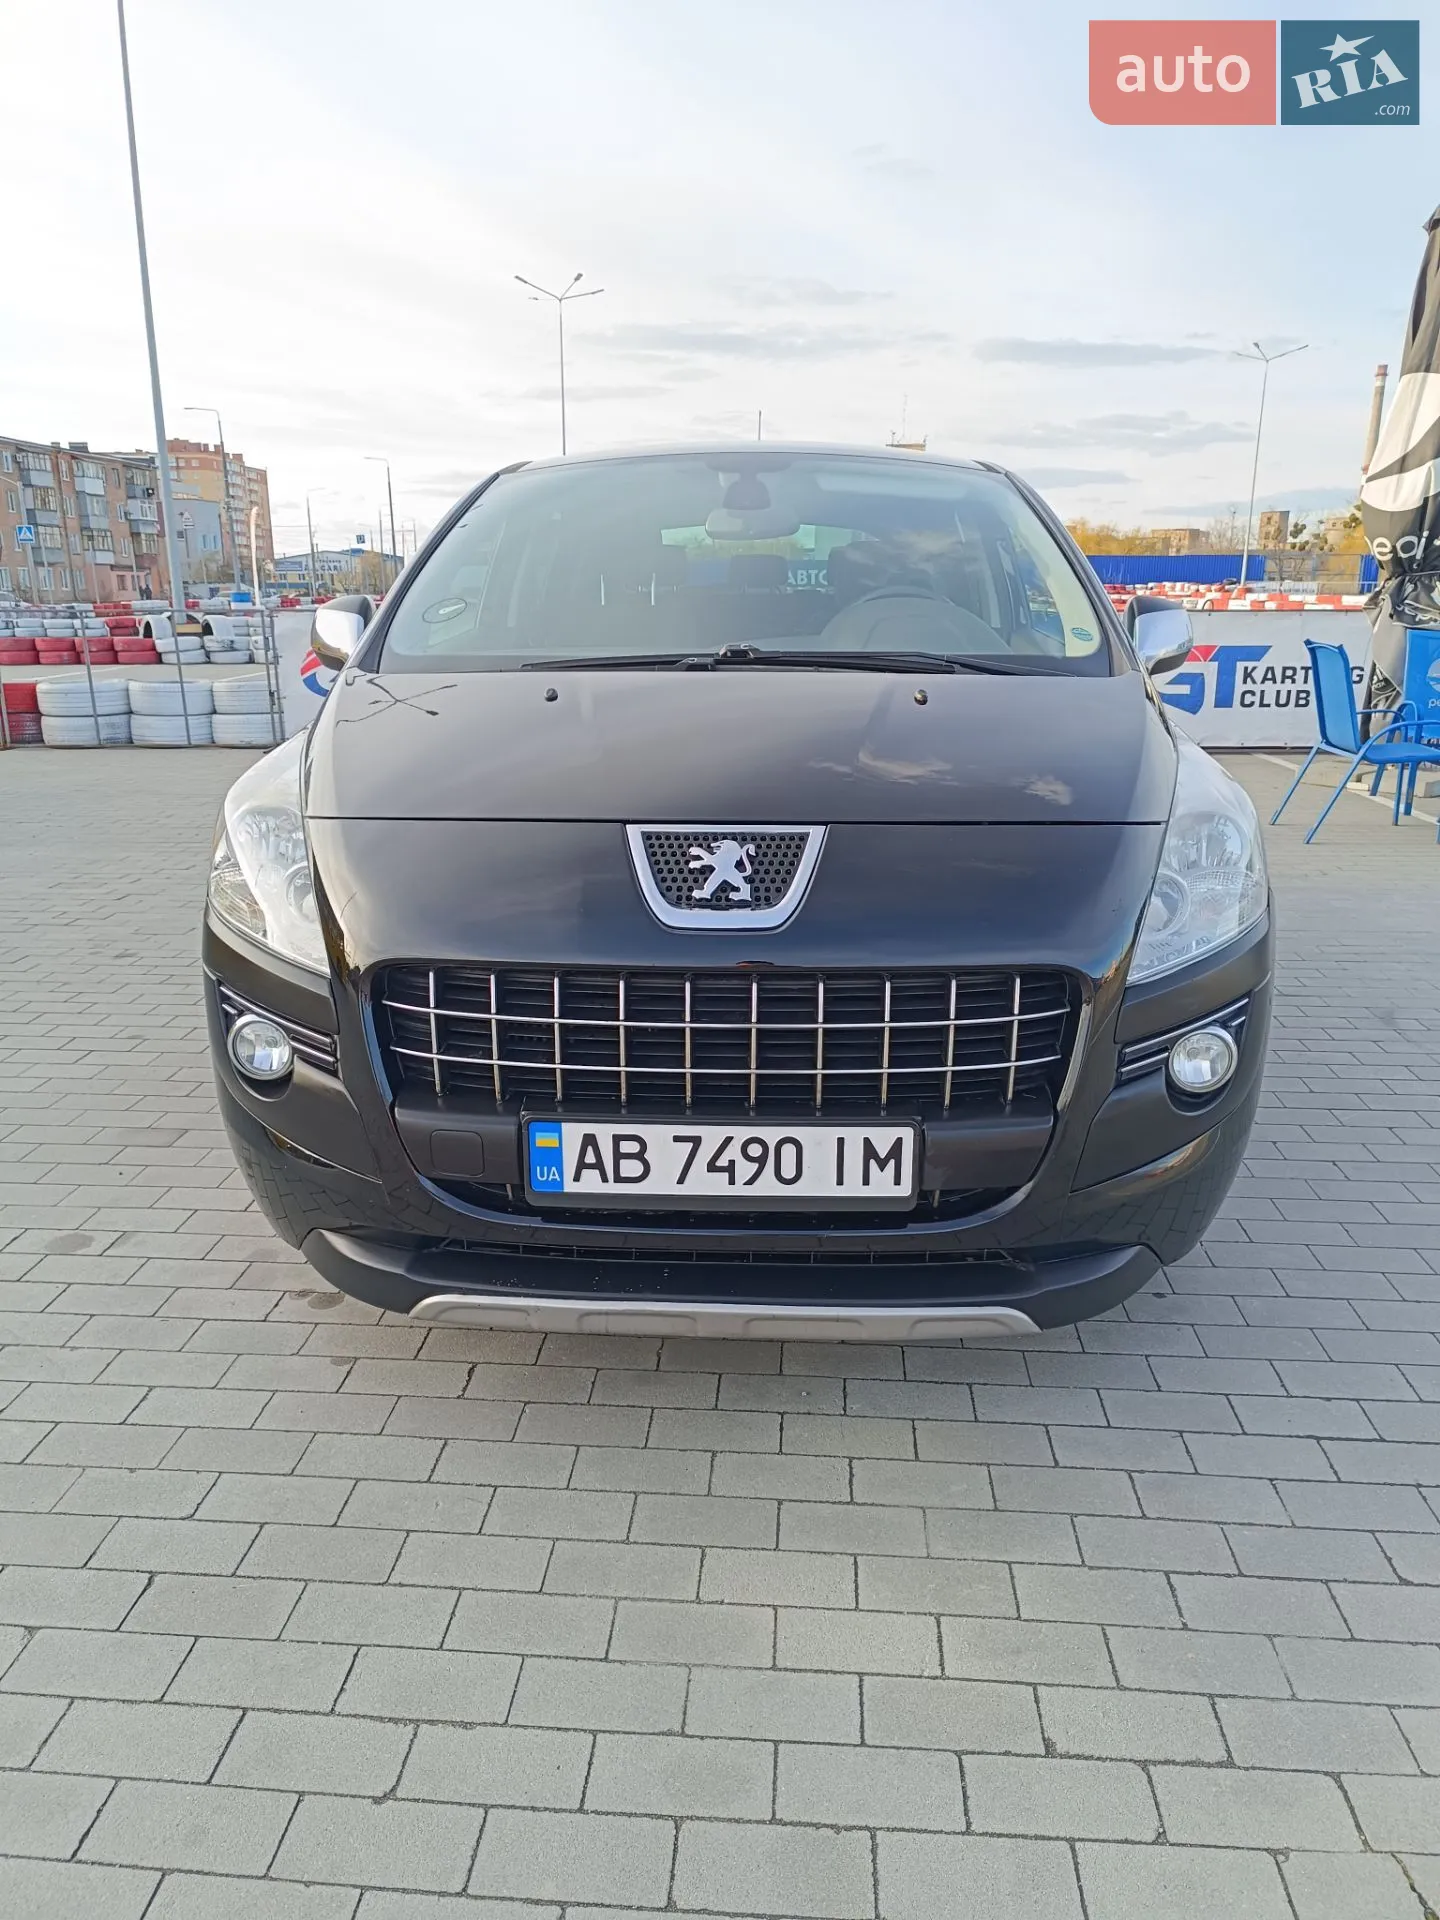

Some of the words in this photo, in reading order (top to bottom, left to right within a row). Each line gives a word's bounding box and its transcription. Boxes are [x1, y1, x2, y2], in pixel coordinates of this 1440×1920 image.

[1241, 665, 1365, 685] KARTG
[1239, 688, 1311, 709] CLUB
[572, 1132, 651, 1184] AB
[671, 1134, 804, 1187] 7490
[835, 1135, 903, 1187] IM
[536, 1166, 561, 1182] UA
